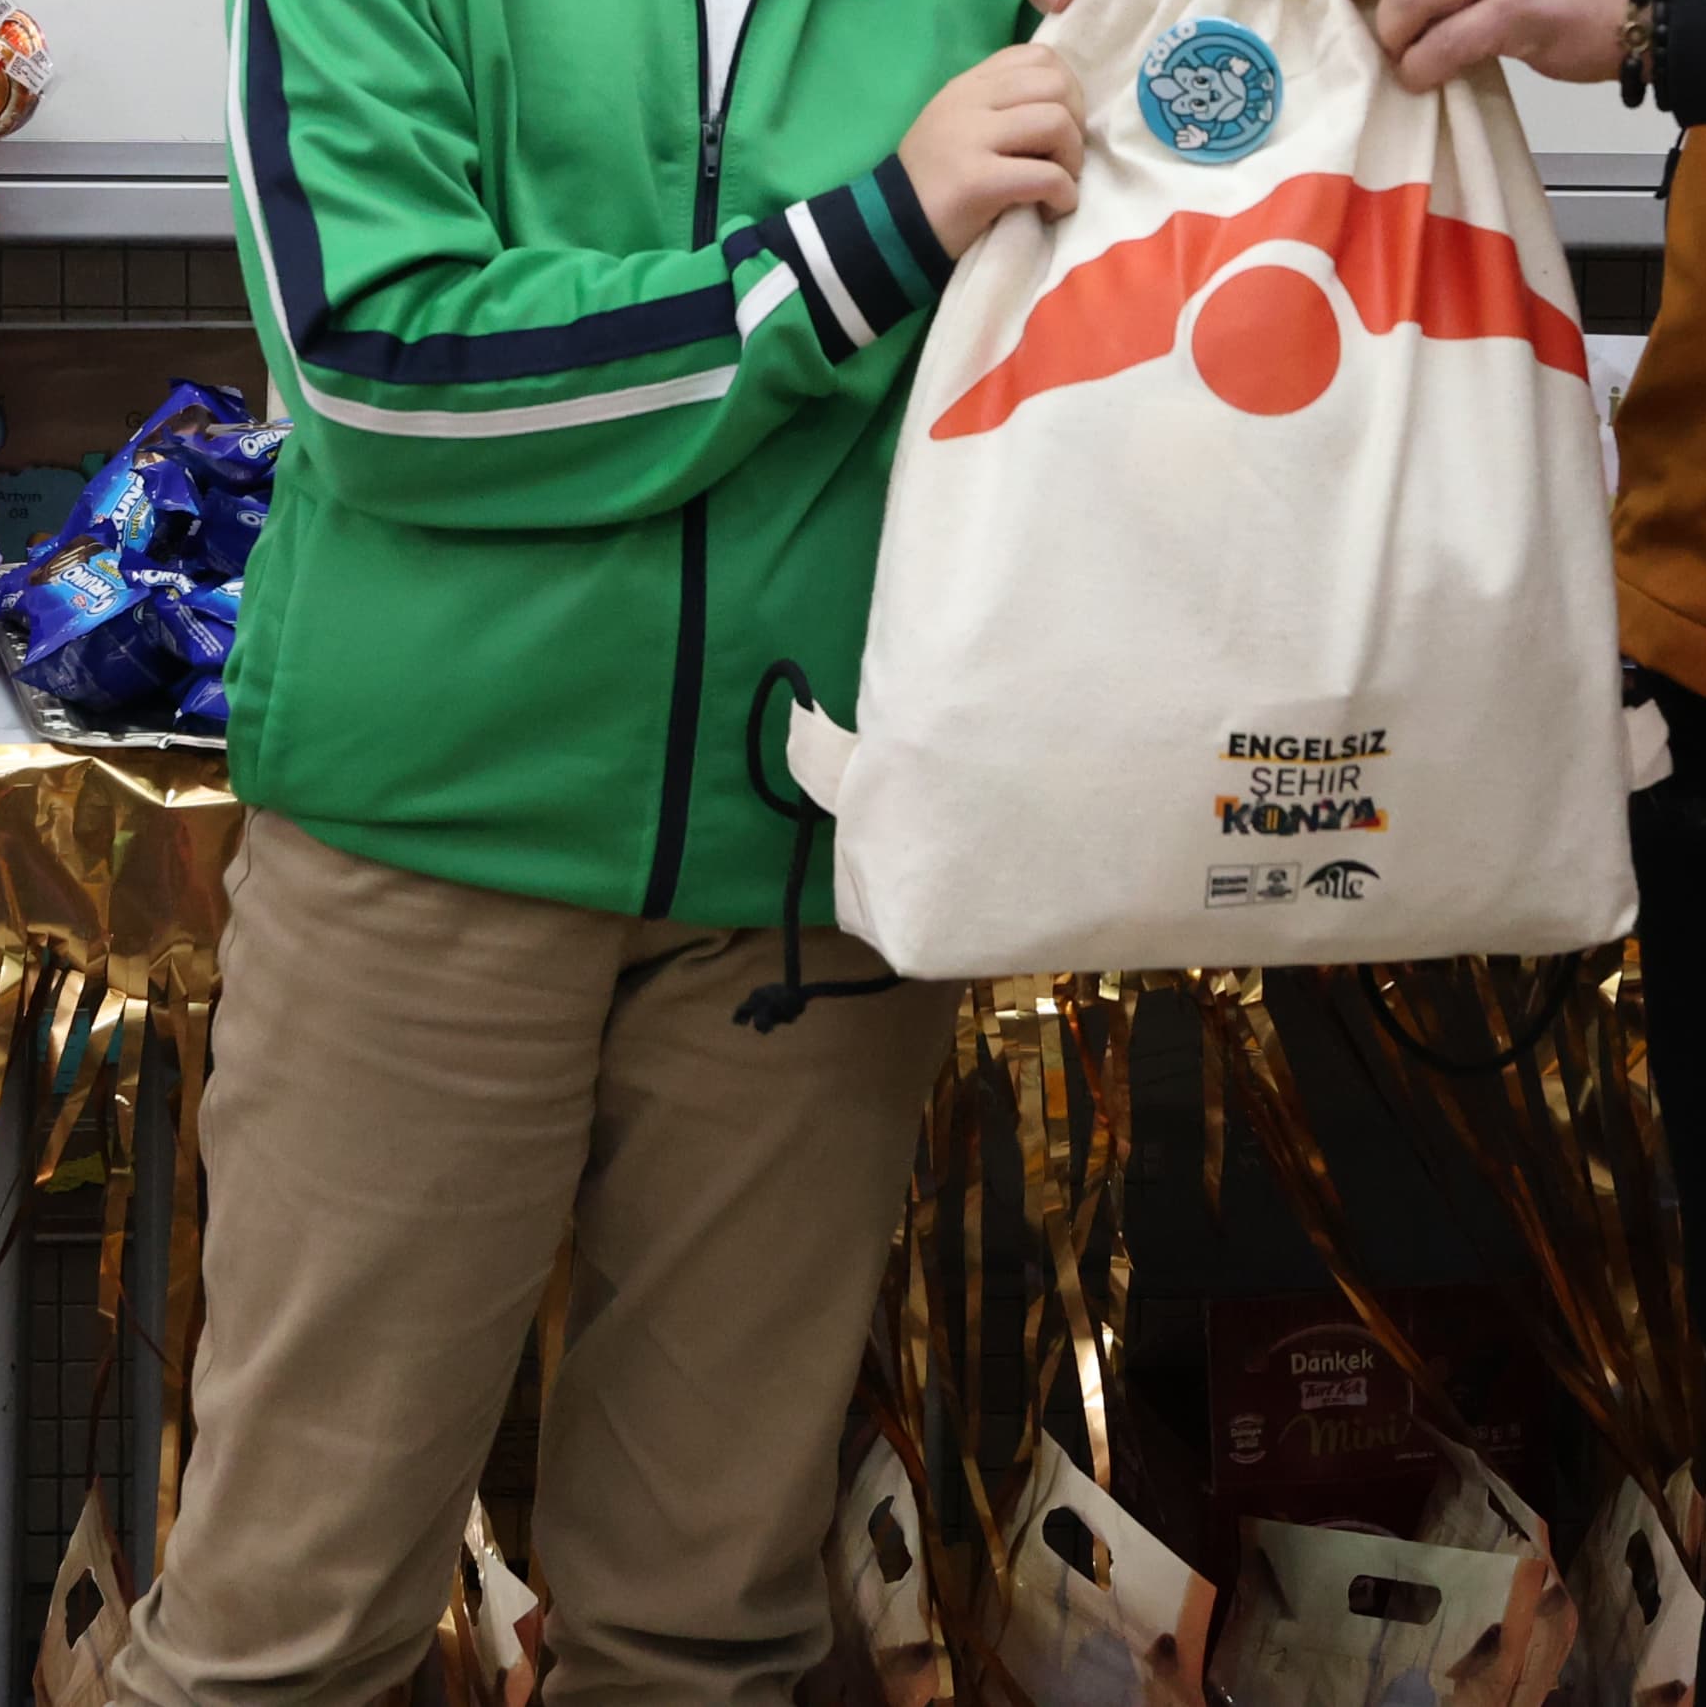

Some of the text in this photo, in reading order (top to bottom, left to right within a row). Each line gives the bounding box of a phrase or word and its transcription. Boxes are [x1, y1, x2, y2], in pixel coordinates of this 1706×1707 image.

[1228, 730, 1386, 761] ENGELSİZ
[1250, 765, 1361, 800] ŞEHİR
[1222, 797, 1381, 836] KONYA
[1290, 1348, 1374, 1375] Dankek
